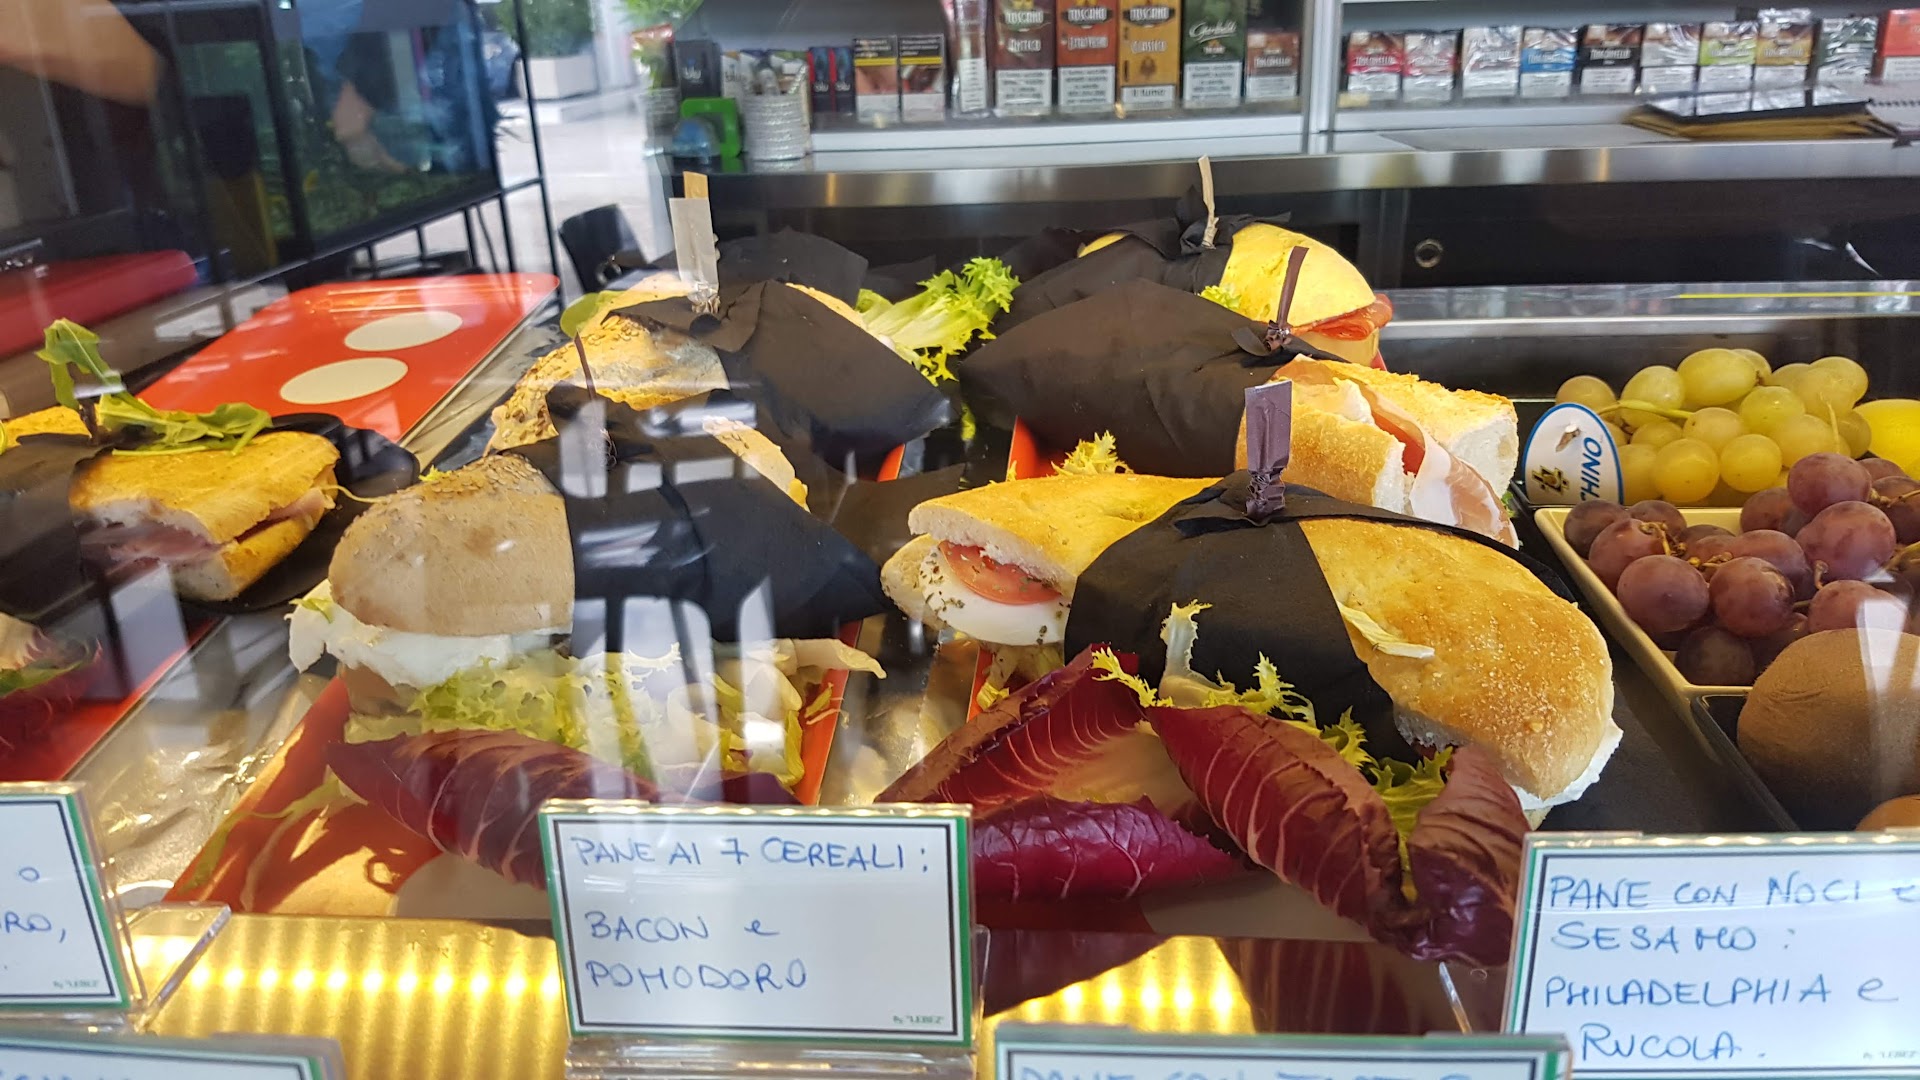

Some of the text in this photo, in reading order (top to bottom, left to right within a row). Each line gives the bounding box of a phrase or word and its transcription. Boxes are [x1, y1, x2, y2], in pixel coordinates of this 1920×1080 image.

[570, 837, 655, 866] PANE
[669, 844, 701, 865] AI
[720, 839, 750, 864] 7
[1551, 877, 1651, 909] PANE
[1674, 882, 1738, 904] CON
[1767, 871, 1861, 905] NOCI
[584, 911, 780, 943] BACON e
[585, 958, 807, 994] POMODORO
[1546, 973, 1899, 1008] PHILADELPHIA e
